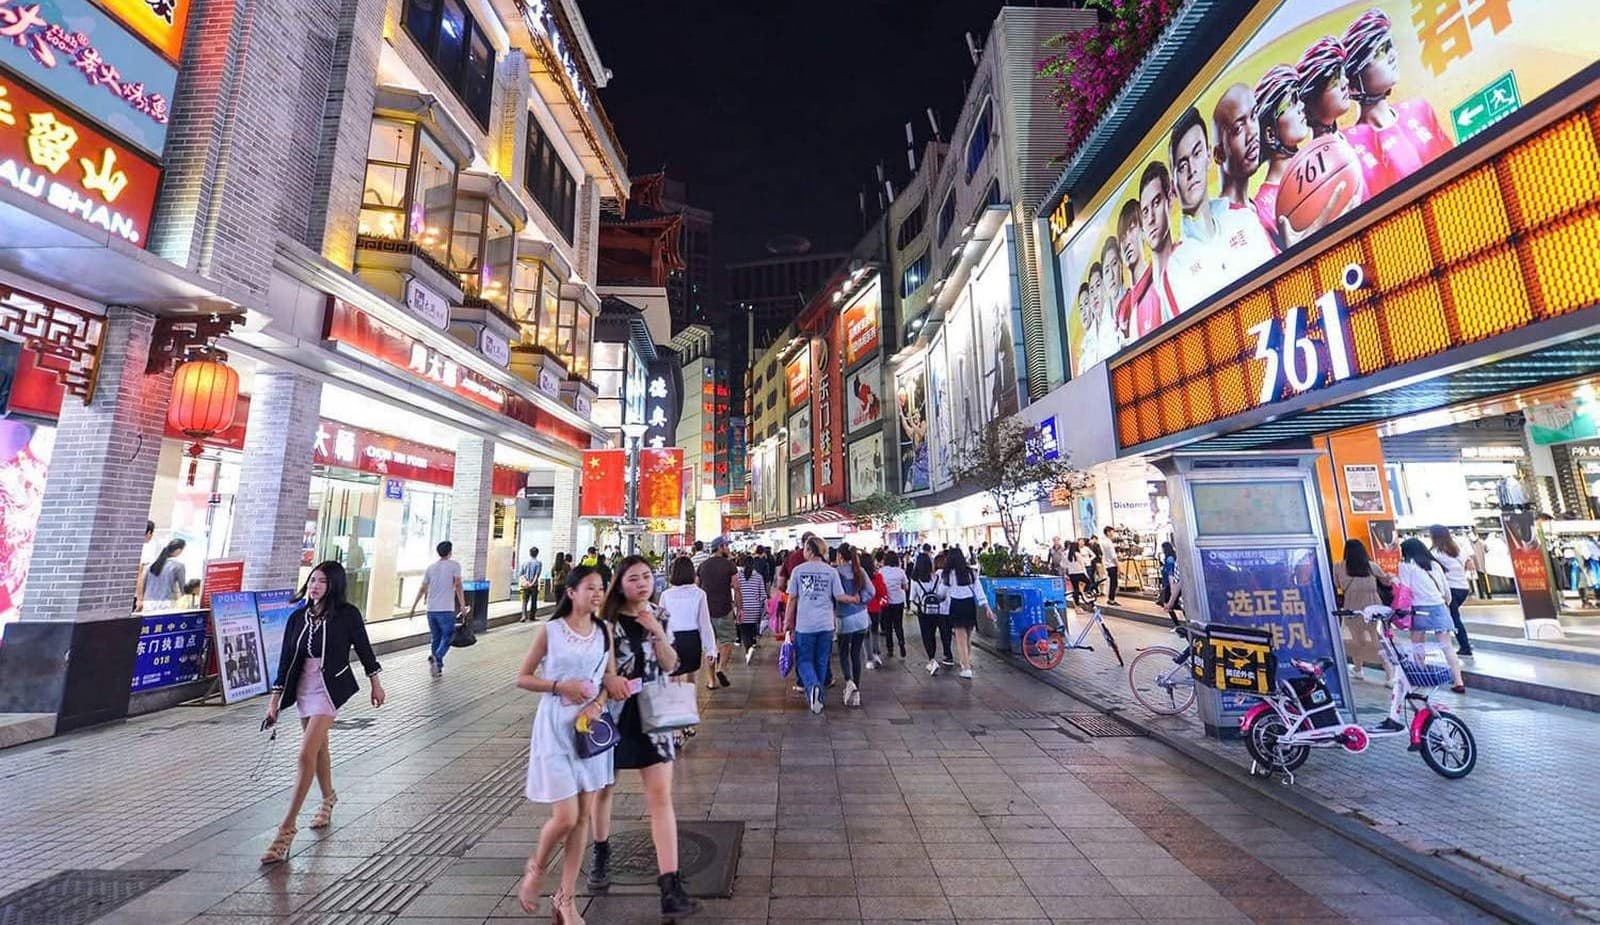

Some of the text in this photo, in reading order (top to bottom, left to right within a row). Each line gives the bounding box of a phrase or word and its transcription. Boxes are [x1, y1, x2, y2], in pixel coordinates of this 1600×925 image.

[1049, 193, 1069, 242] 361°
[1247, 263, 1363, 404] 361°
[217, 593, 249, 603] POLICE
[1226, 588, 1307, 617] 选正品
